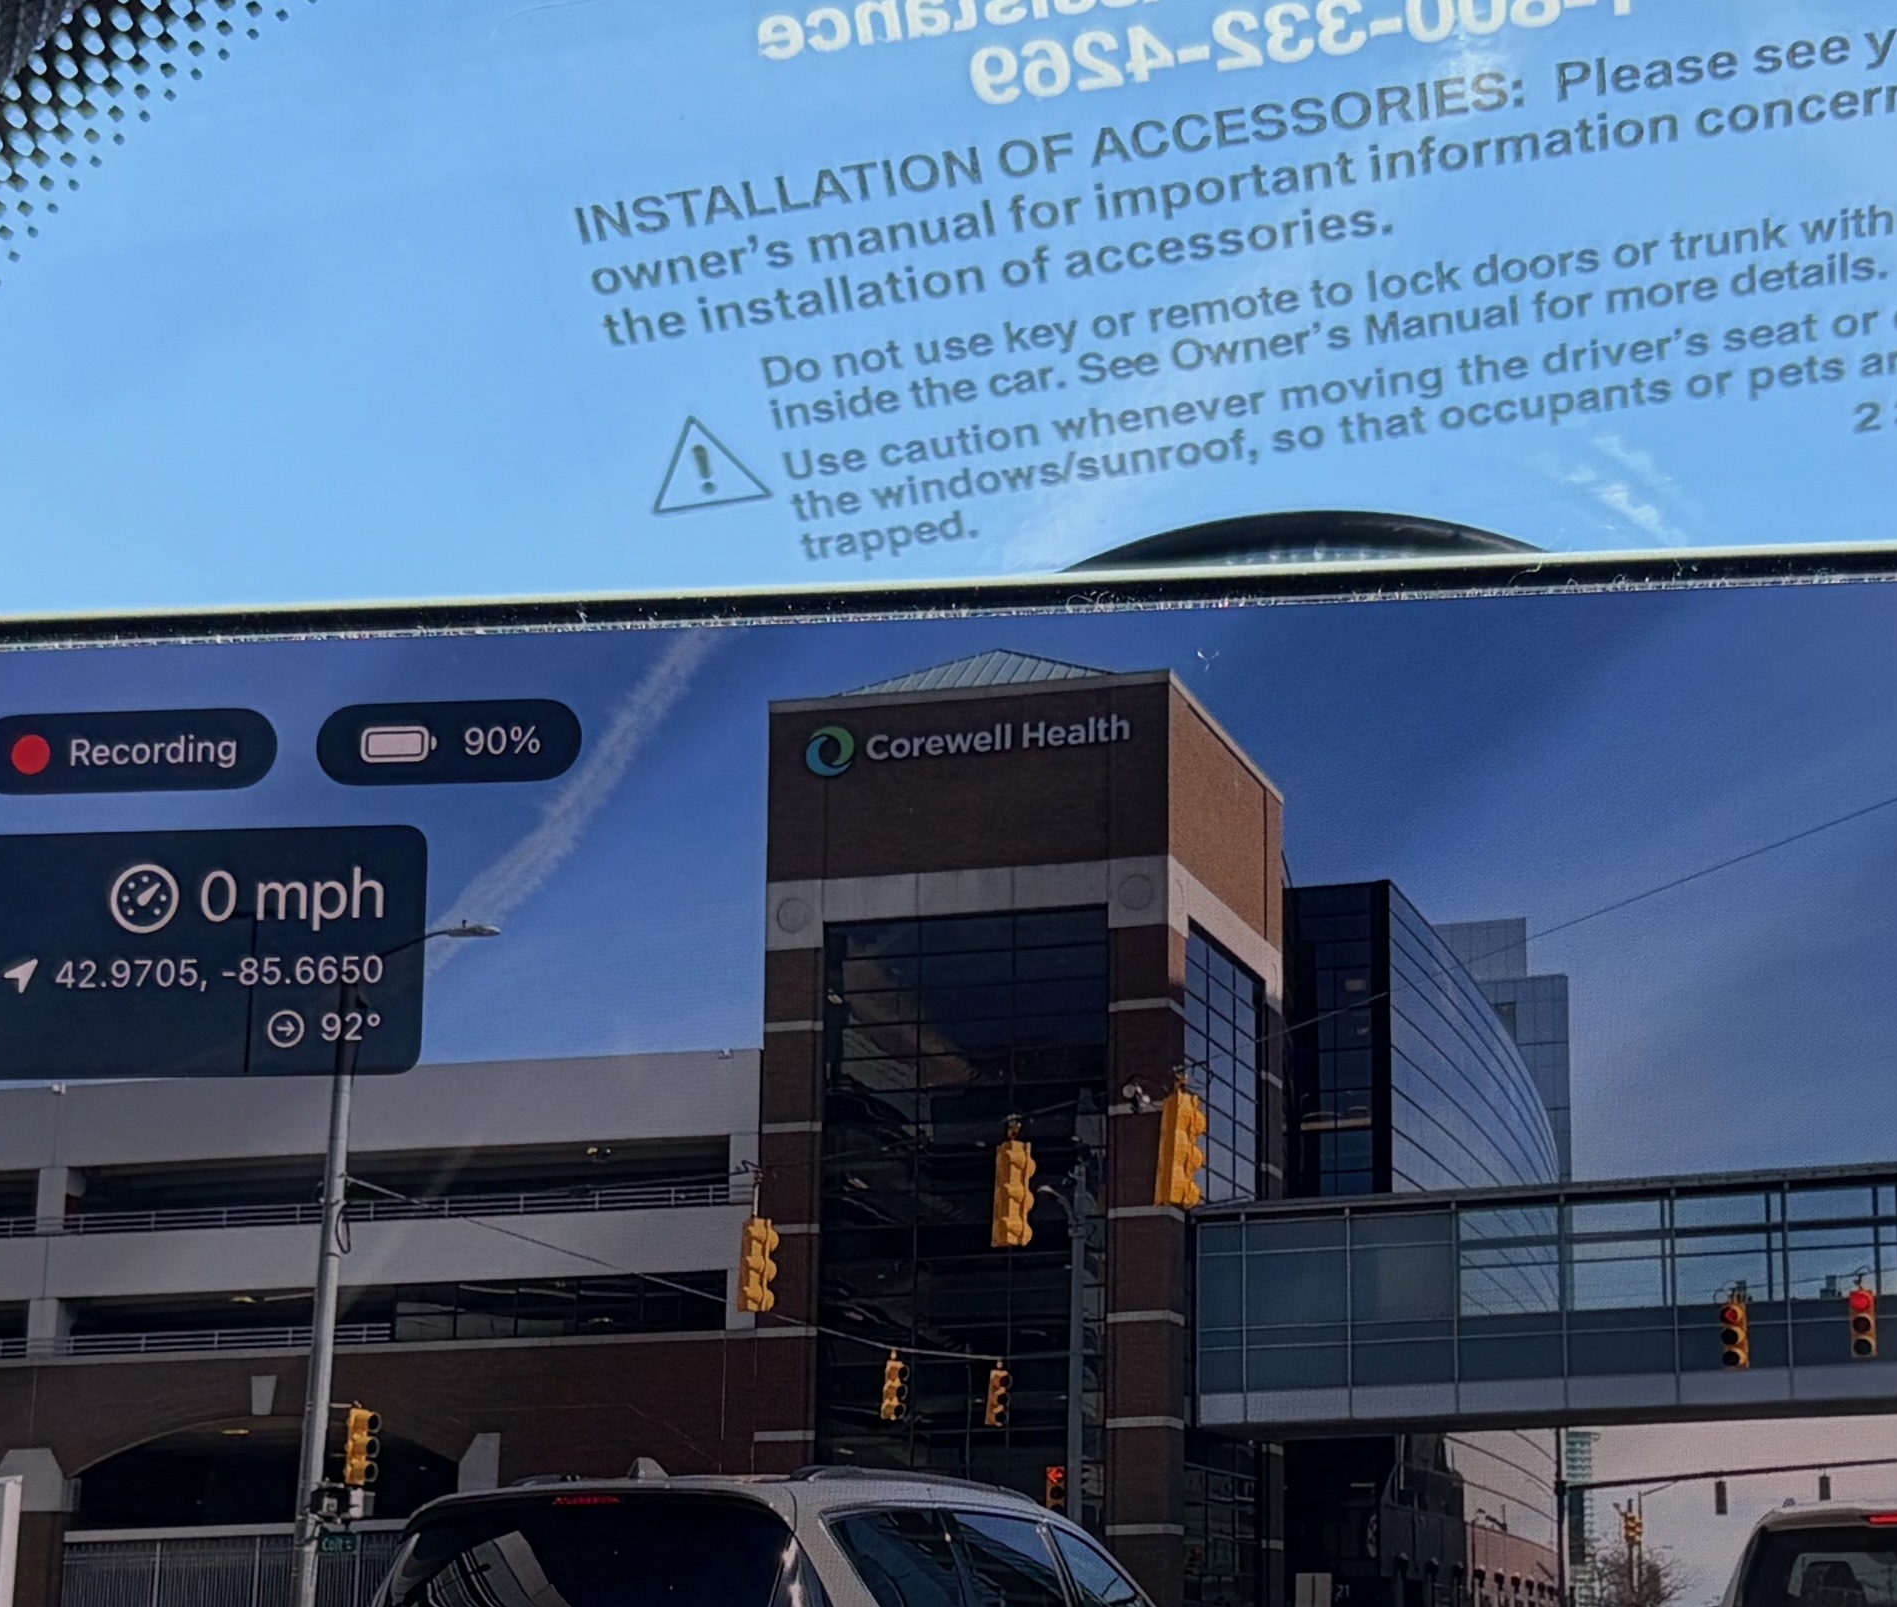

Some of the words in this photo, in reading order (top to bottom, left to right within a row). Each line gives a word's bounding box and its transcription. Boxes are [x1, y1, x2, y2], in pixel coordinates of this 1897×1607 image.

[574, 146, 982, 245] INSTALLATION
[999, 132, 1073, 178] OF
[1091, 73, 1524, 168] ACCESSORIES:
[1556, 52, 1737, 102] Please
[1754, 36, 1850, 74] see
[592, 235, 794, 295] owner's
[808, 199, 996, 263] manual
[1008, 194, 1082, 232] for
[1094, 152, 1356, 220] important
[1369, 112, 1678, 182] information
[602, 308, 686, 346] the
[697, 265, 985, 333] installation
[1001, 245, 1050, 288] of
[1065, 208, 1393, 278] accessories.
[760, 356, 821, 388] Do
[833, 340, 903, 378] not
[914, 333, 994, 365] use
[1003, 320, 1078, 354] key
[1092, 311, 1135, 339] or
[1148, 287, 1299, 332] remote
[1310, 280, 1353, 309] to
[1367, 261, 1461, 302] lock
[1473, 249, 1599, 287] doors
[1613, 240, 1659, 268] or
[1670, 218, 1787, 261] trunk
[1799, 204, 1893, 244] with
[769, 386, 900, 430] inside
[908, 377, 978, 408] the
[989, 367, 1066, 397] car.
[1078, 352, 1159, 384] See
[1171, 321, 1351, 370] Owner's
[1365, 295, 1518, 345] Manual
[1531, 290, 1593, 322] for
[1607, 277, 1718, 314] more
[1731, 252, 1888, 297] details.
[782, 449, 867, 480] Use
[880, 424, 1040, 466] caution
[1051, 391, 1265, 441] whenever
[1280, 367, 1442, 410] moving
[1458, 354, 1528, 386] the
[1543, 328, 1709, 375] driver's
[1723, 314, 1817, 352] seat
[1832, 311, 1879, 338] or
[790, 490, 861, 521] the
[870, 428, 1258, 509] windows/sunroof,
[1272, 425, 1324, 453] so
[1338, 406, 1426, 444] that
[1439, 377, 1671, 430] occupants
[1687, 370, 1732, 398] or
[1749, 356, 1845, 401] pets
[1854, 402, 1881, 433] 2
[800, 510, 979, 561] trapped.
[70, 734, 238, 769] Recording
[464, 725, 541, 756] 90%
[866, 722, 1012, 760] Corewell
[1022, 713, 1131, 749] Health
[200, 870, 237, 922] 0
[256, 866, 385, 932] mph
[55, 958, 208, 992] 42.9705,
[222, 954, 384, 986] -85.6650
